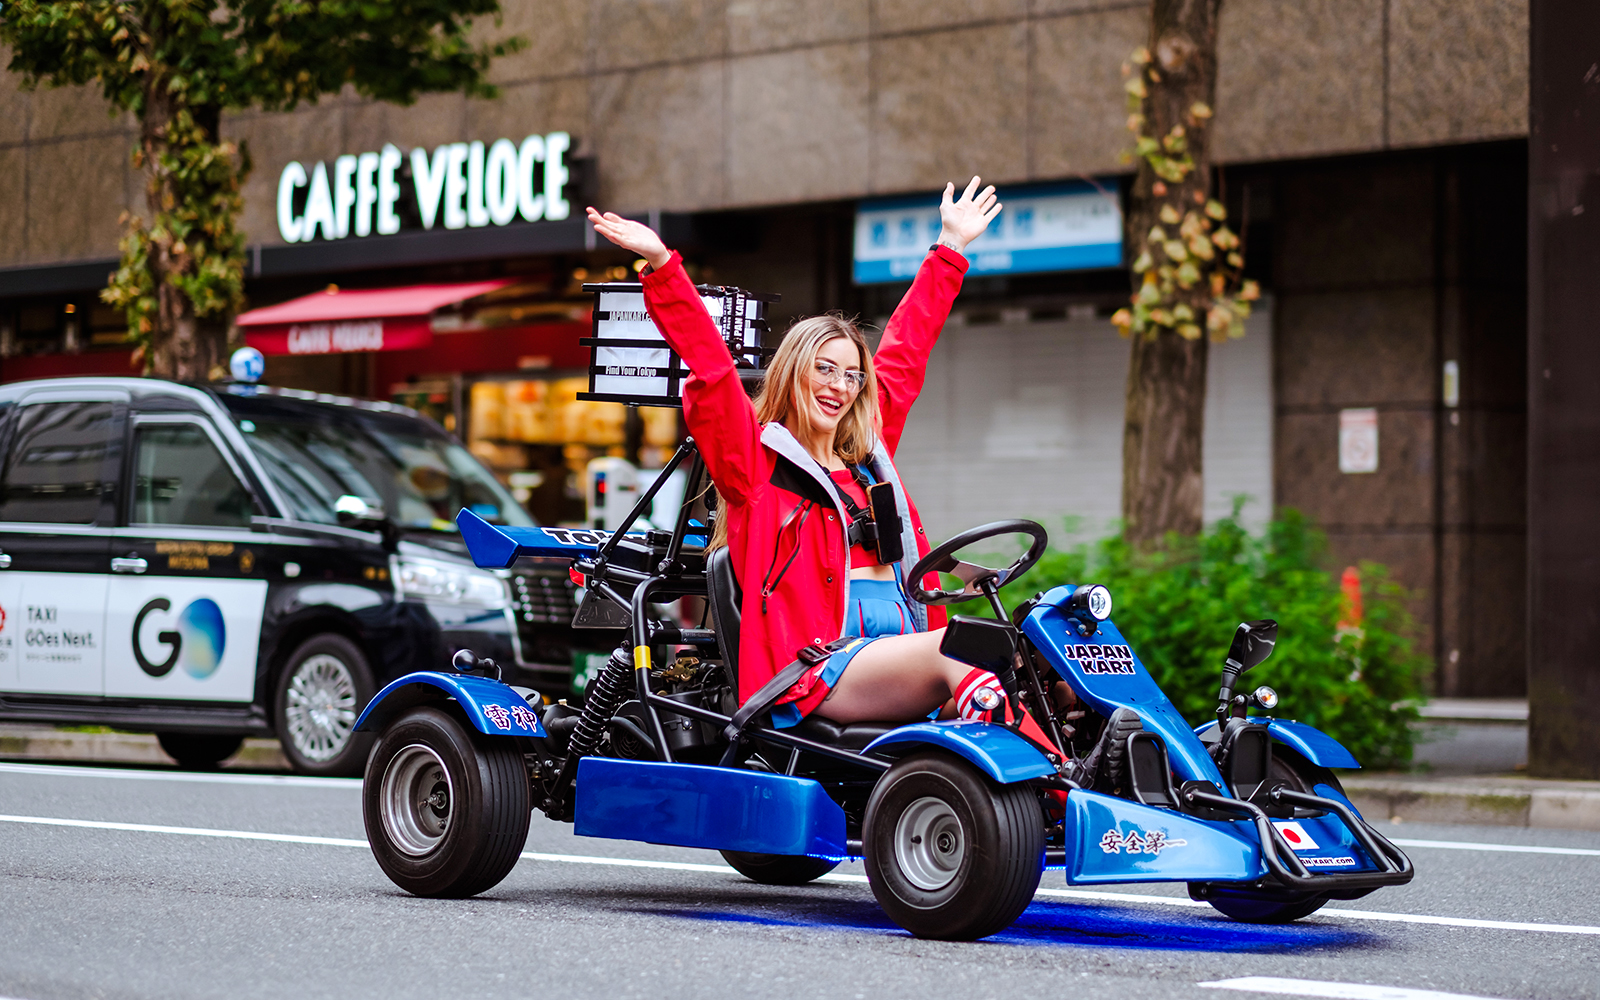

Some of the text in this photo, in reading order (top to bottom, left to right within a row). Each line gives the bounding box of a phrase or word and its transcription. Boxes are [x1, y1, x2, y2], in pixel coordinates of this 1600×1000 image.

[277, 131, 570, 243] CAFFÈ VELOCE
[734, 293, 746, 316] KART
[605, 365, 657, 377] Find Your Tokyo
[28, 606, 57, 623] TAXI
[26, 628, 60, 648] GOes
[62, 629, 97, 648] Next.
[1064, 644, 1134, 660] JAPAN
[1079, 658, 1136, 675] KART
[482, 704, 537, 733] 雷神
[1099, 829, 1187, 855] 安全第一
